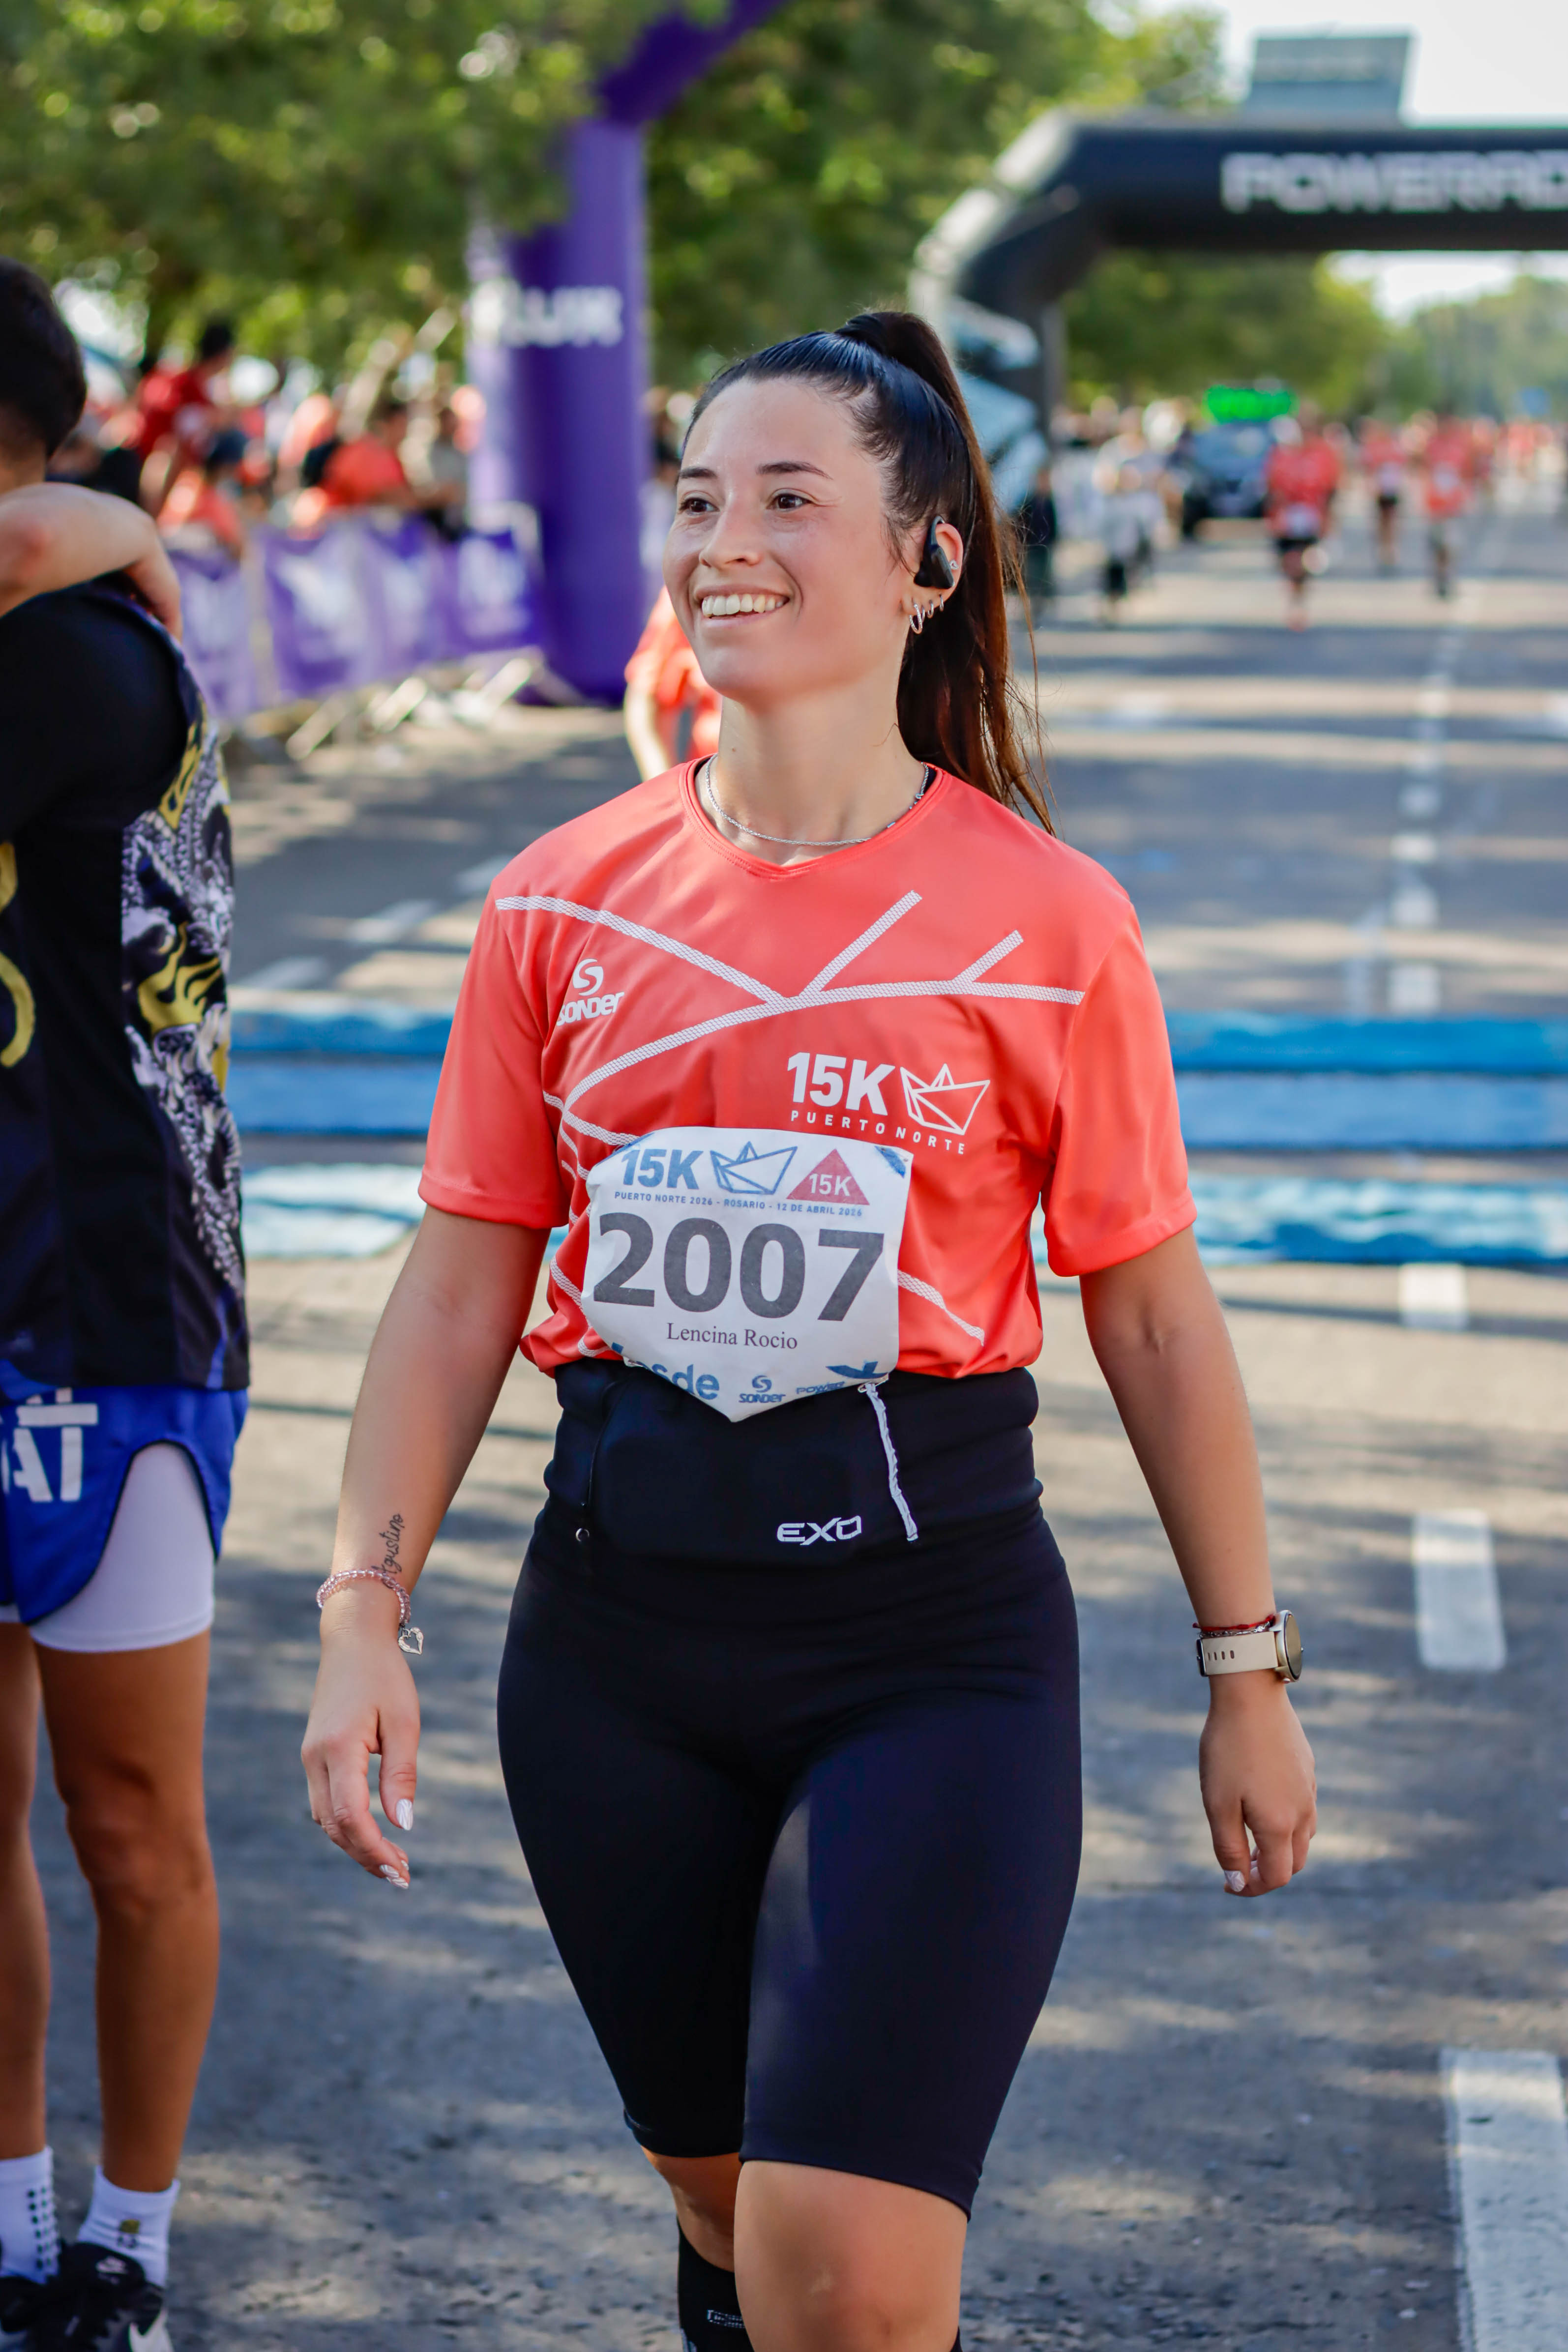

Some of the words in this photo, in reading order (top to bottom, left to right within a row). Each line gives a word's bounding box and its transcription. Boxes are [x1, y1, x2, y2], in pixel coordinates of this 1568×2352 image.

[787, 1052, 896, 1116] 15K
[791, 1110, 885, 1134] PUERTO
[896, 1126, 965, 1155] NORTE
[621, 1148, 704, 1190] 15K
[808, 1173, 854, 1197] 15K
[615, 1191, 651, 1202] PUERTO
[655, 1195, 686, 1204] NORTE
[689, 1196, 713, 1205] 2026
[724, 1199, 765, 1209] ROSARIO
[806, 1205, 835, 1215] ABRIL
[838, 1207, 862, 1217] 2026
[593, 1212, 885, 1322] 2007
[667, 1322, 738, 1345] Lencina
[743, 1328, 798, 1350] Rocio
[777, 1515, 861, 1546] EXO
